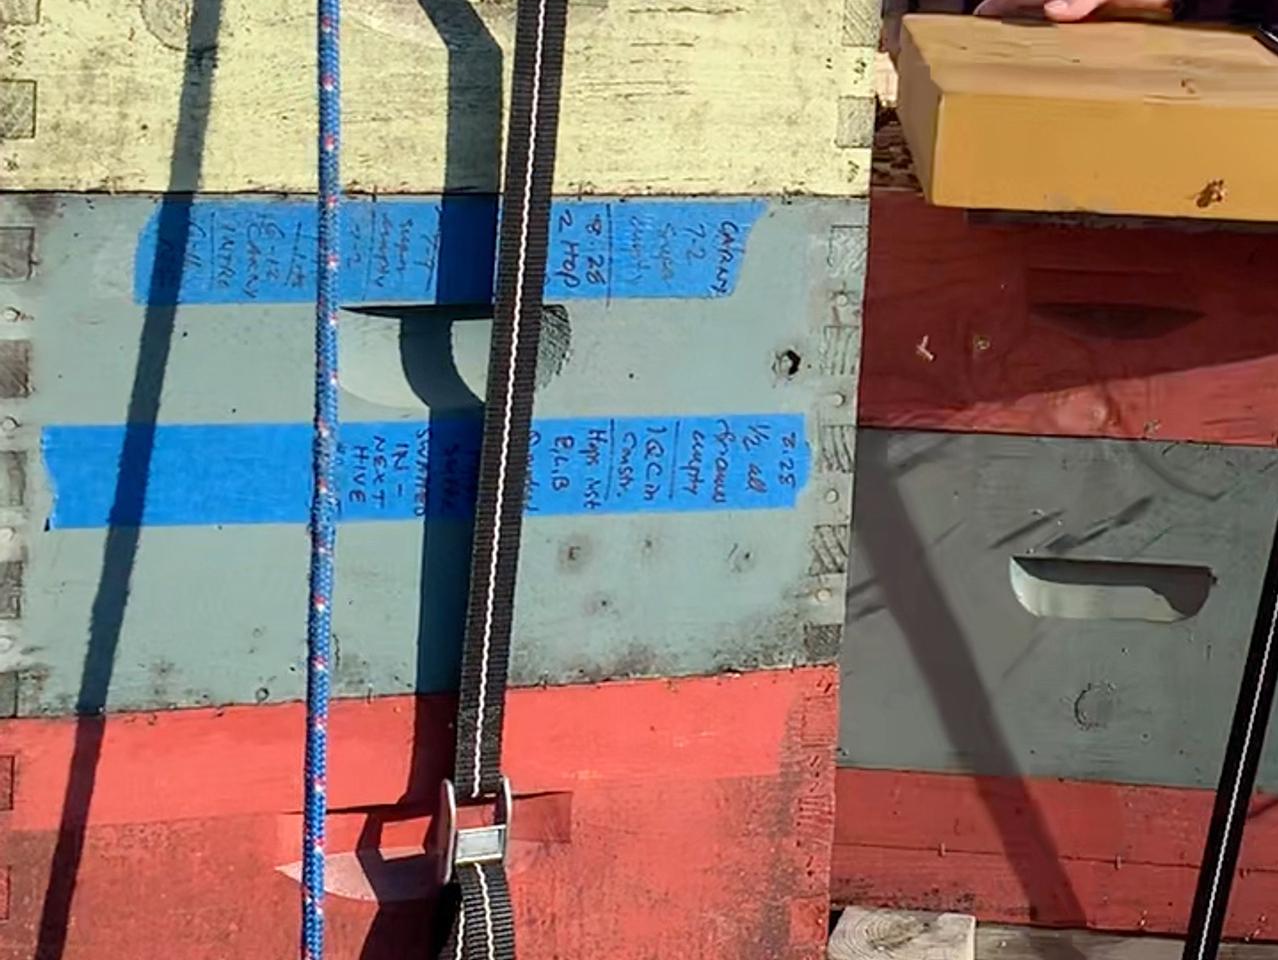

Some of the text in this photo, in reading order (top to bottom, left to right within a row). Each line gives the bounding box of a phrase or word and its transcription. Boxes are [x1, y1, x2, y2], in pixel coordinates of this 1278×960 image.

[348, 444, 369, 503] HIVE
[372, 435, 388, 509] NEXT
[391, 442, 411, 471] IN
